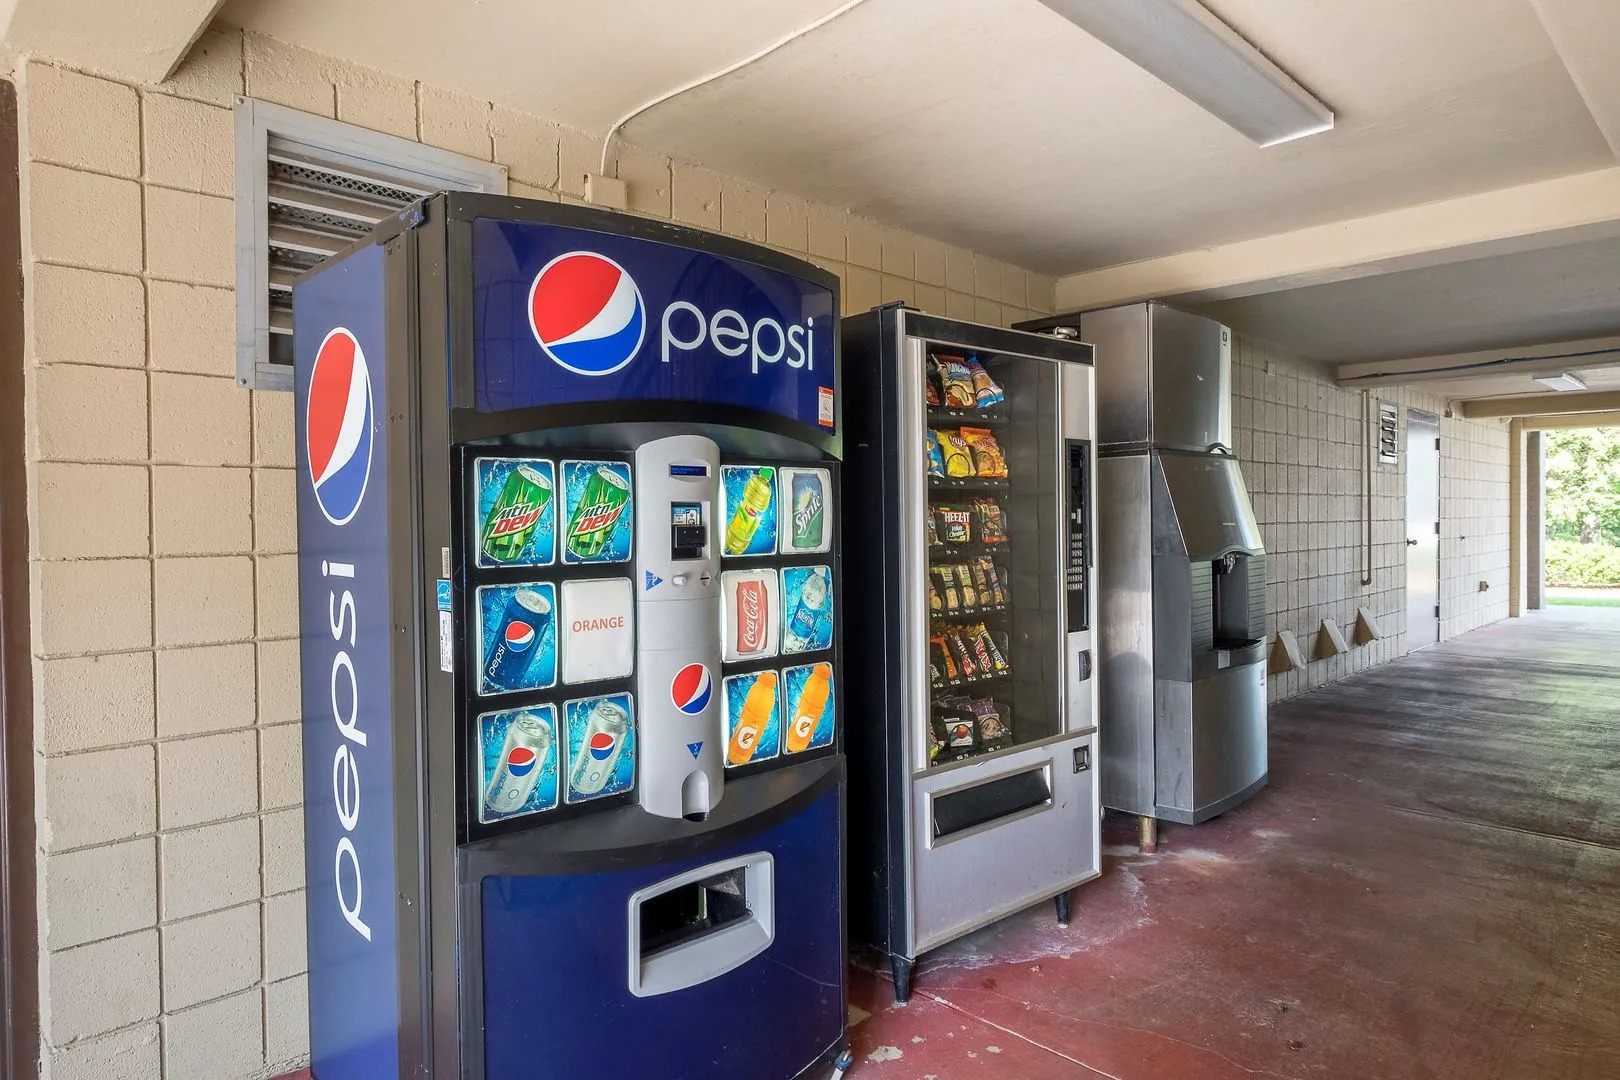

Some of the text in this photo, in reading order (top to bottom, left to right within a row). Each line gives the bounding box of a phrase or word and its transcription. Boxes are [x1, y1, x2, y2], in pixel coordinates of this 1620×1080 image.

[662, 301, 814, 374] pepsi
[796, 495, 823, 535] Sprite
[572, 616, 625, 633] ORANGE
[488, 643, 506, 678] pepsi
[322, 560, 371, 942] pepsi
